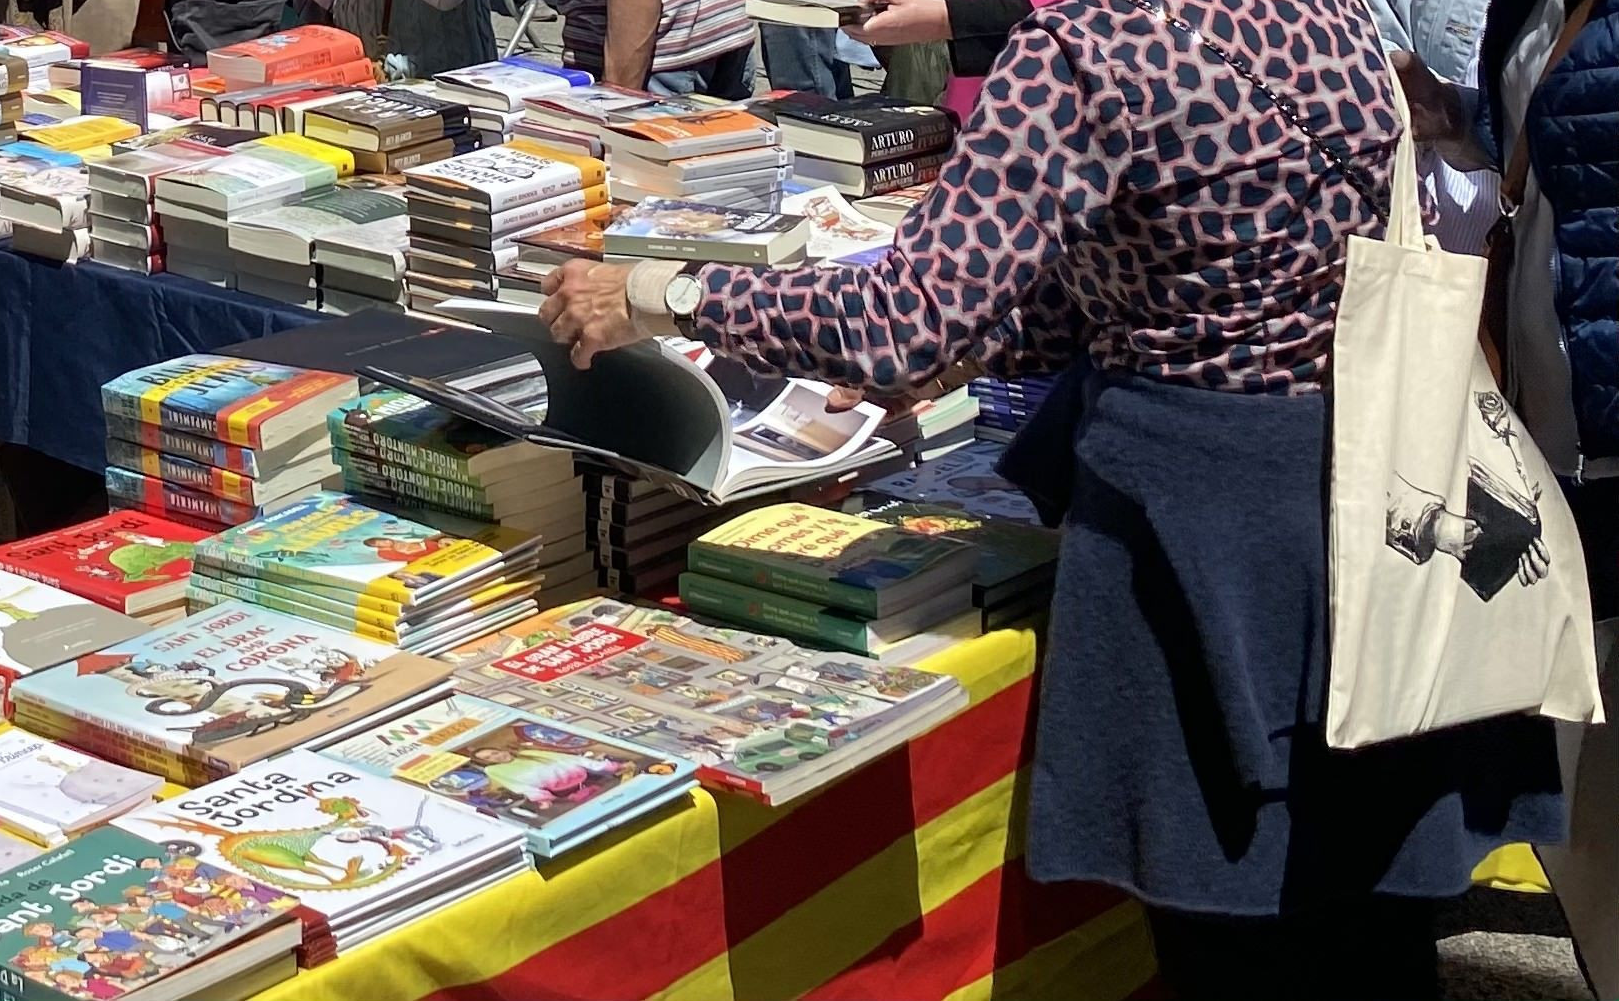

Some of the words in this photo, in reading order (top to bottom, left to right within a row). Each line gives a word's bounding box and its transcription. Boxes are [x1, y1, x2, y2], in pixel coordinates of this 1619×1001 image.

[871, 129, 914, 150] ARTURO
[872, 161, 915, 184] ARTURO
[165, 434, 214, 458] AMPAMENTO
[373, 432, 418, 457] MONTORO
[418, 447, 458, 470] MIQUEL
[382, 465, 430, 486] MONTORO
[436, 477, 473, 498] MIQUEL
[170, 493, 222, 517] AMPAMENTO
[6, 539, 78, 561] Sant
[74, 517, 151, 544] Jordi
[732, 526, 780, 548] Dime
[777, 512, 810, 528] qué
[767, 528, 814, 554] omes
[815, 528, 850, 547] qué
[153, 631, 201, 653] SANT
[201, 611, 253, 634] JORDI
[193, 642, 226, 659] EL
[222, 624, 275, 648] DRAC
[225, 632, 319, 672] CORONA
[502, 660, 527, 670] EL
[524, 644, 564, 663] GRAN
[556, 627, 608, 648] LLIBRE
[540, 649, 581, 668] SANT
[579, 632, 625, 654] JORDI
[177, 772, 298, 816] Santa
[209, 770, 361, 827] Jordina
[29, 877, 53, 891] de
[49, 854, 138, 901] Jordi
[11, 976, 24, 992] La
